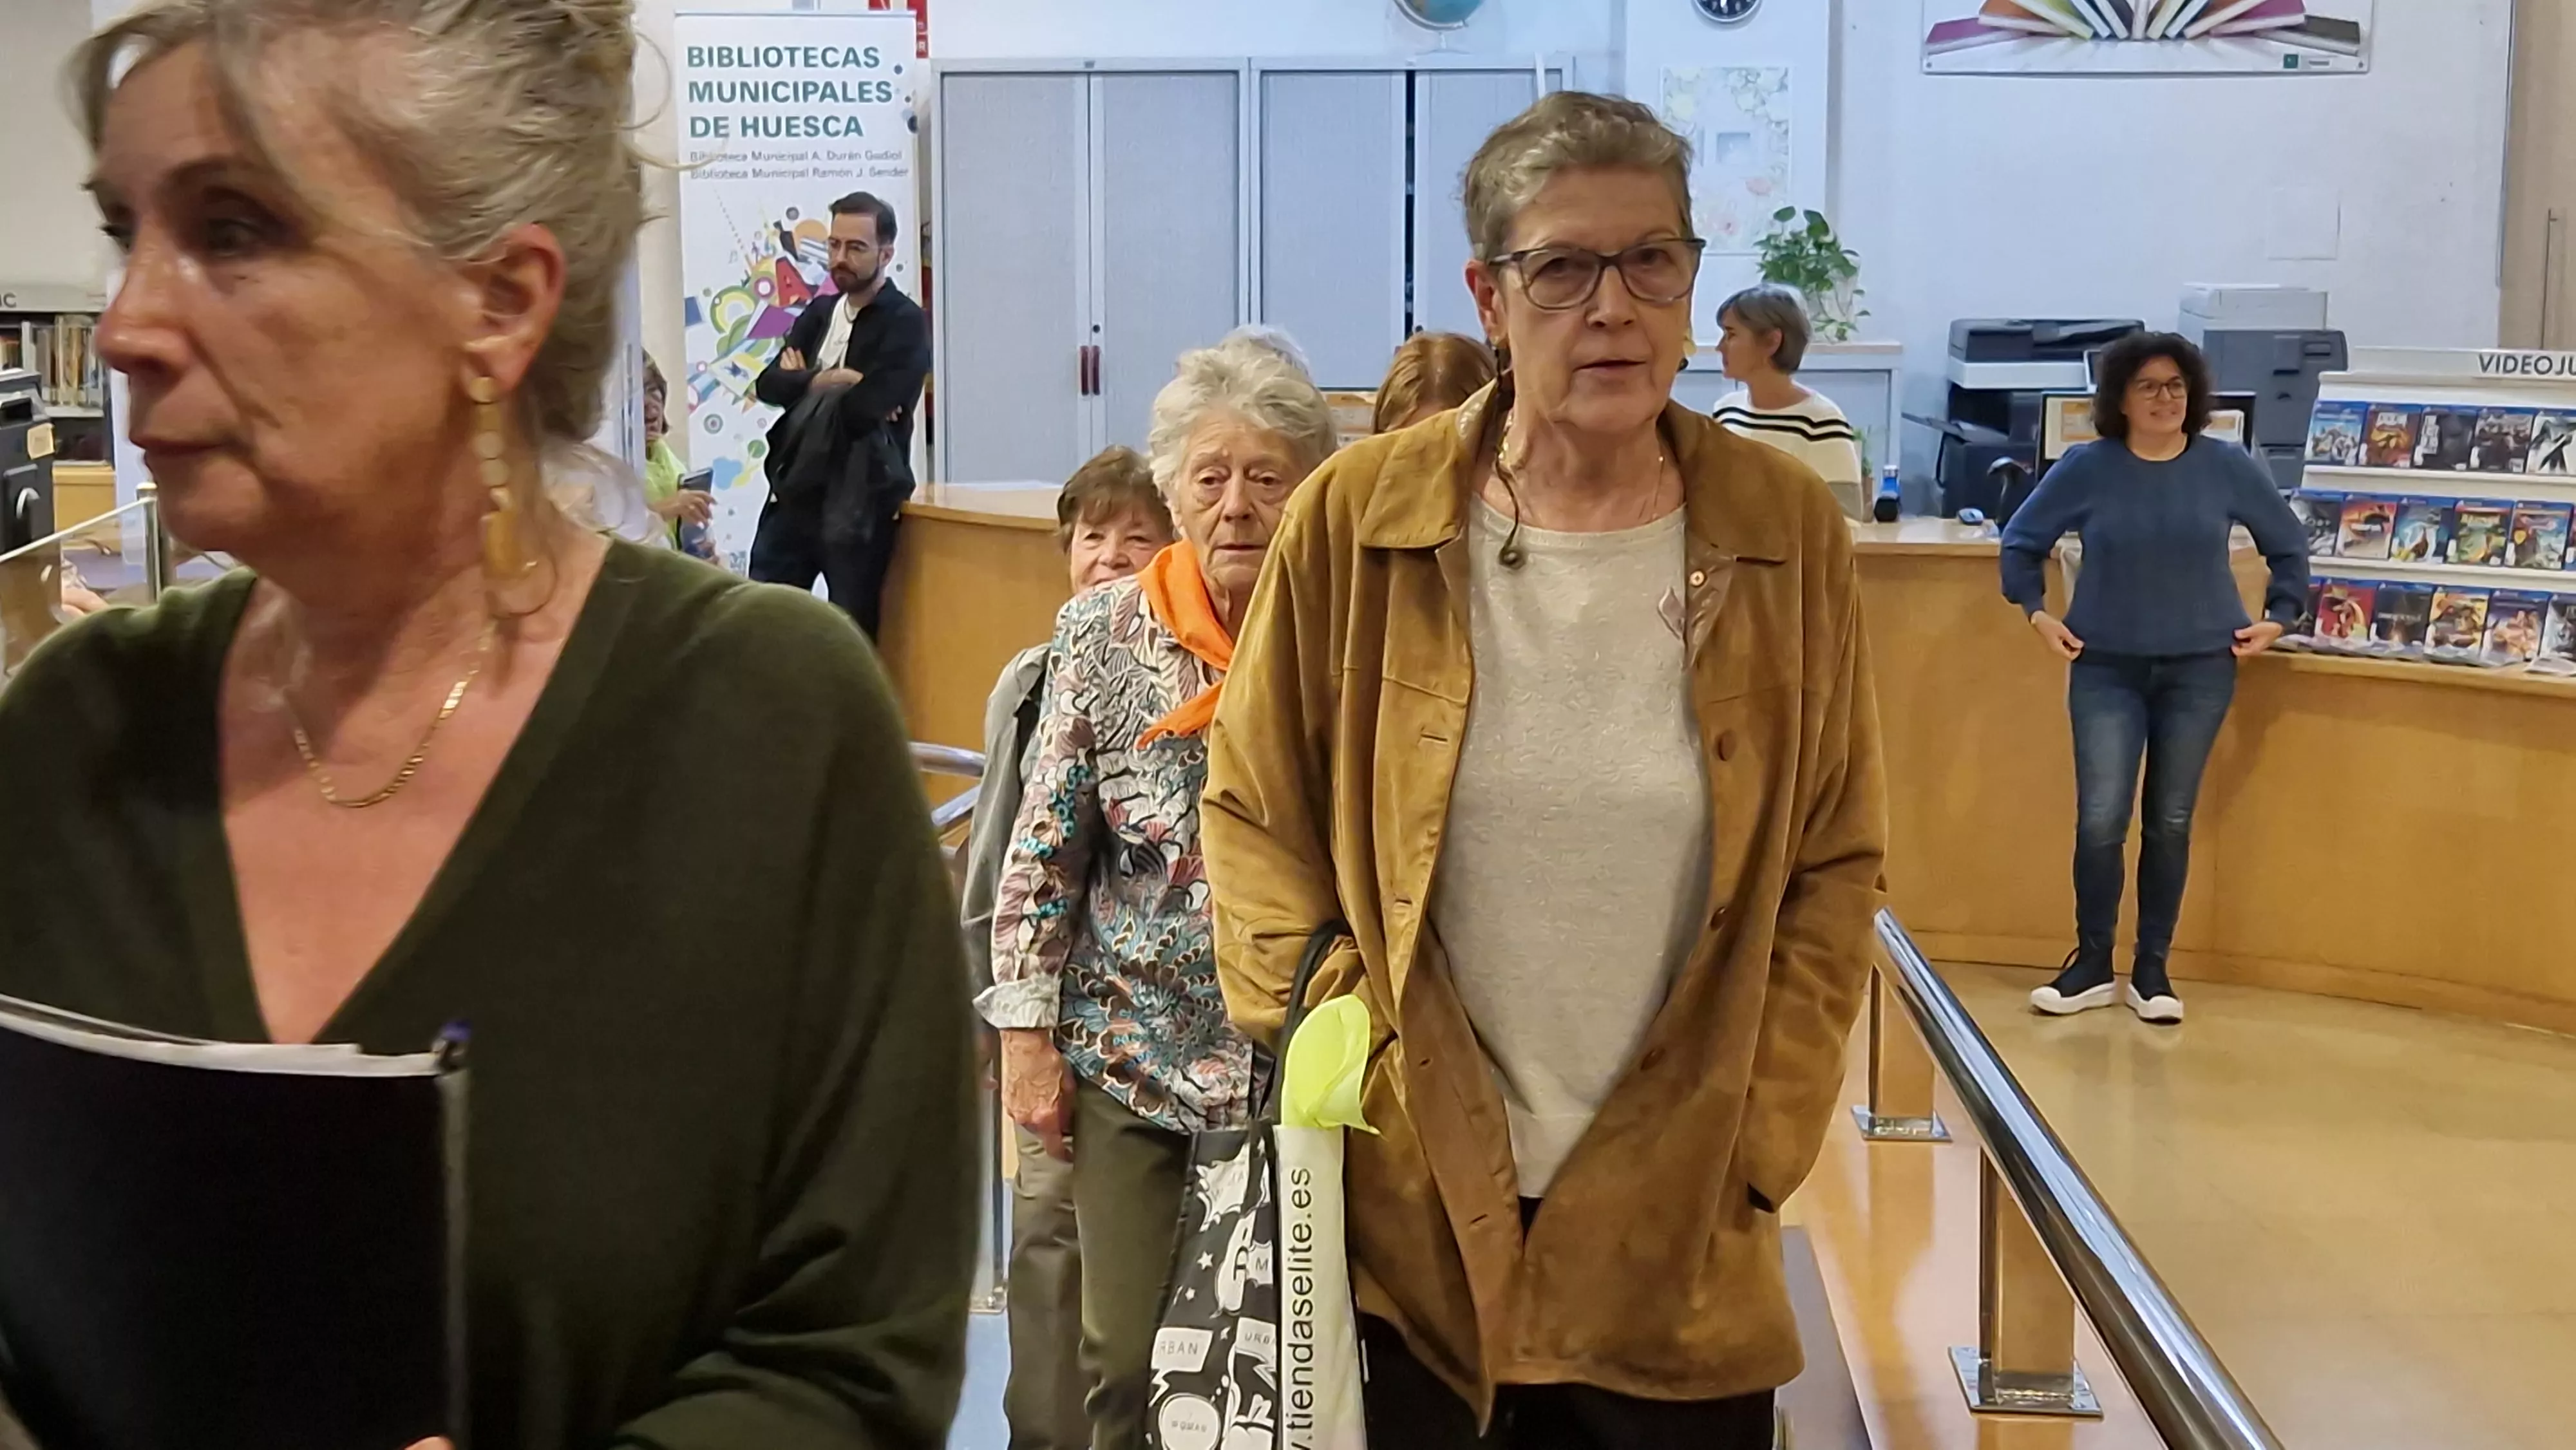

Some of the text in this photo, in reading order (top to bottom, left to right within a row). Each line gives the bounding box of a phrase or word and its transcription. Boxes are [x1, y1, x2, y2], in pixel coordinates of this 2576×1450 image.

[687, 46, 880, 68] BIBLIOTECAS
[688, 80, 893, 103] MUNICIPALES
[690, 115, 864, 138] DE HUESCA
[690, 151, 748, 162] Biboteca
